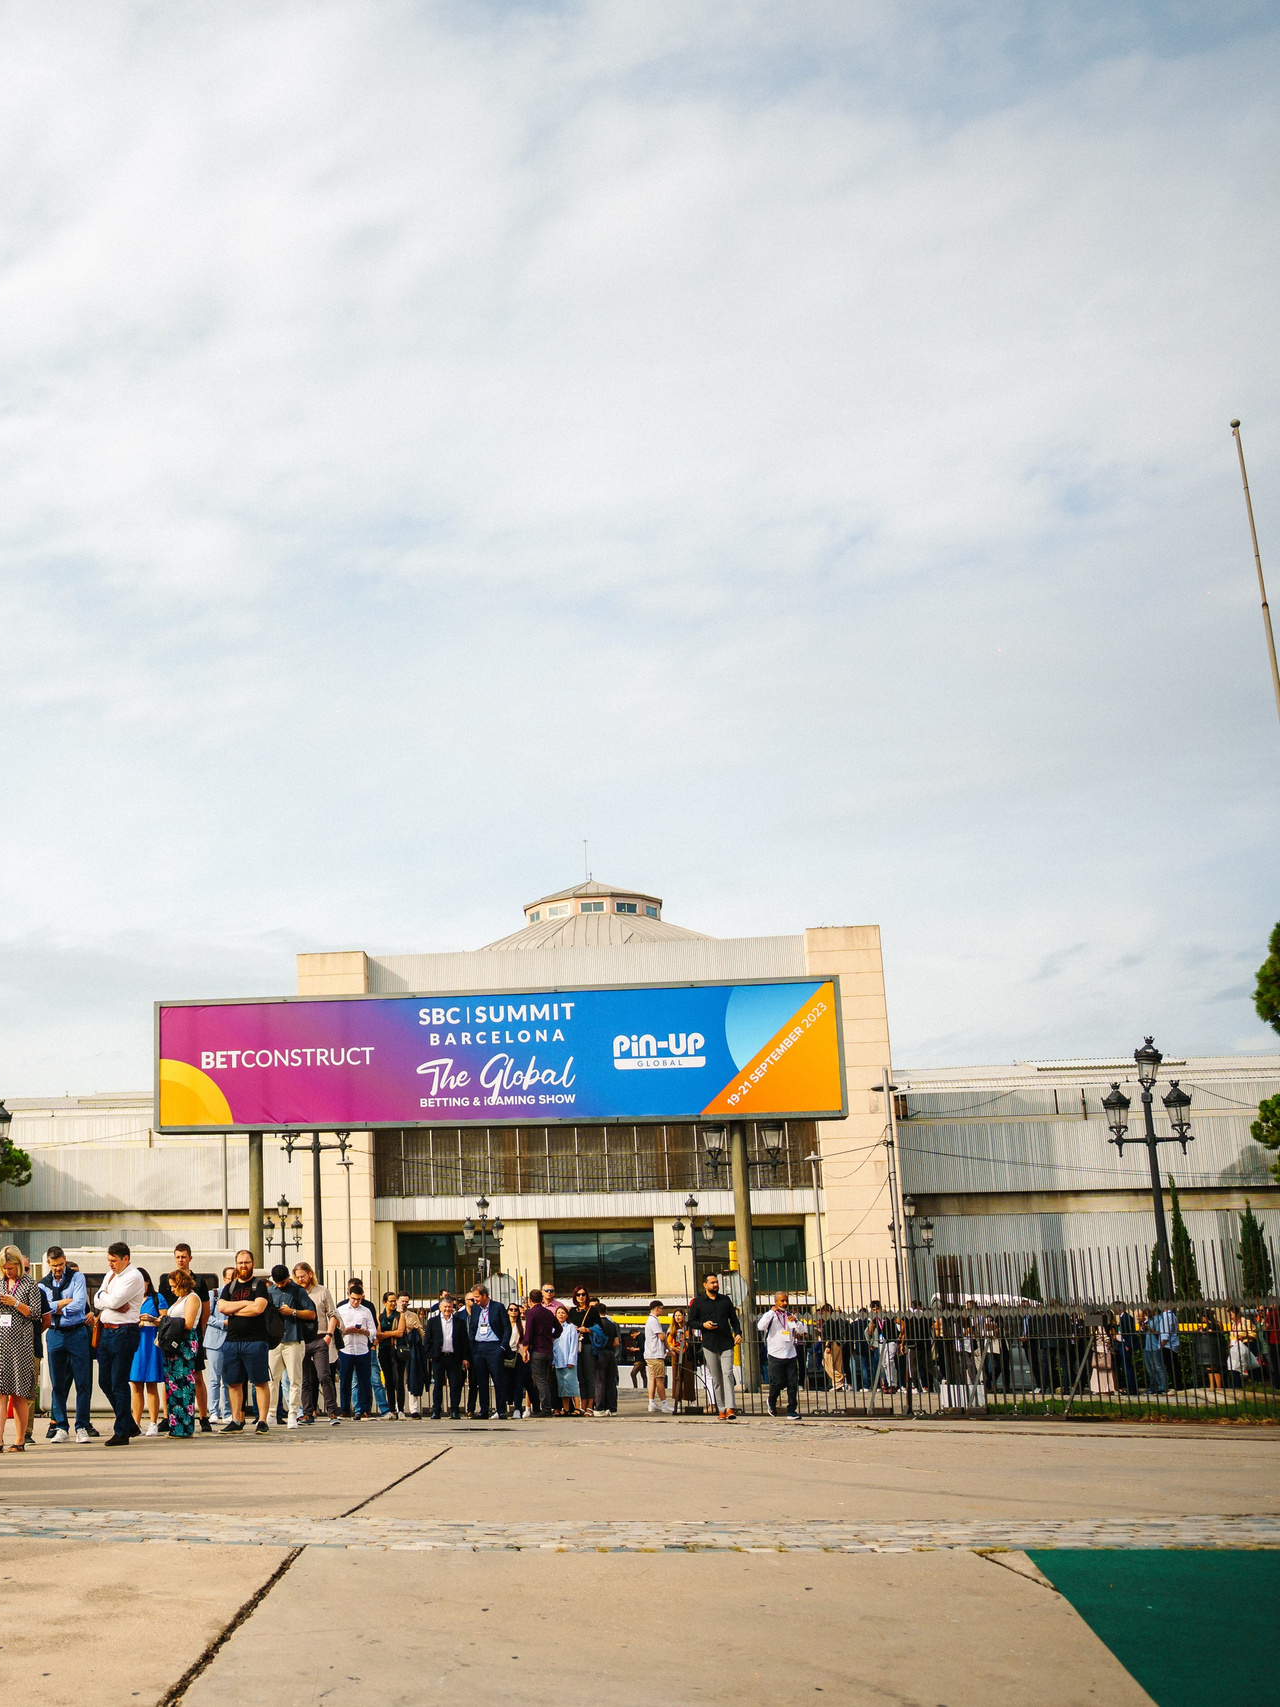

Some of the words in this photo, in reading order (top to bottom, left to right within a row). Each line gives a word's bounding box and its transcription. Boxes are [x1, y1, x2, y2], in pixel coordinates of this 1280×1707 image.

[418, 1007, 461, 1025] SBC
[475, 1003, 575, 1023] SUMMIT
[429, 1029, 565, 1046] BARCELONA
[201, 1047, 375, 1069] BETCONSTRUCT
[637, 1059, 683, 1068] GLOBAL
[727, 1081, 752, 1106] 19-21
[749, 1026, 805, 1083] SEPTEMBER
[801, 1002, 827, 1028] 2023
[416, 1058, 471, 1096] The
[479, 1053, 576, 1101] Global
[420, 1097, 470, 1107] BETTING
[473, 1097, 481, 1106] &
[538, 1094, 576, 1104] SHOW
